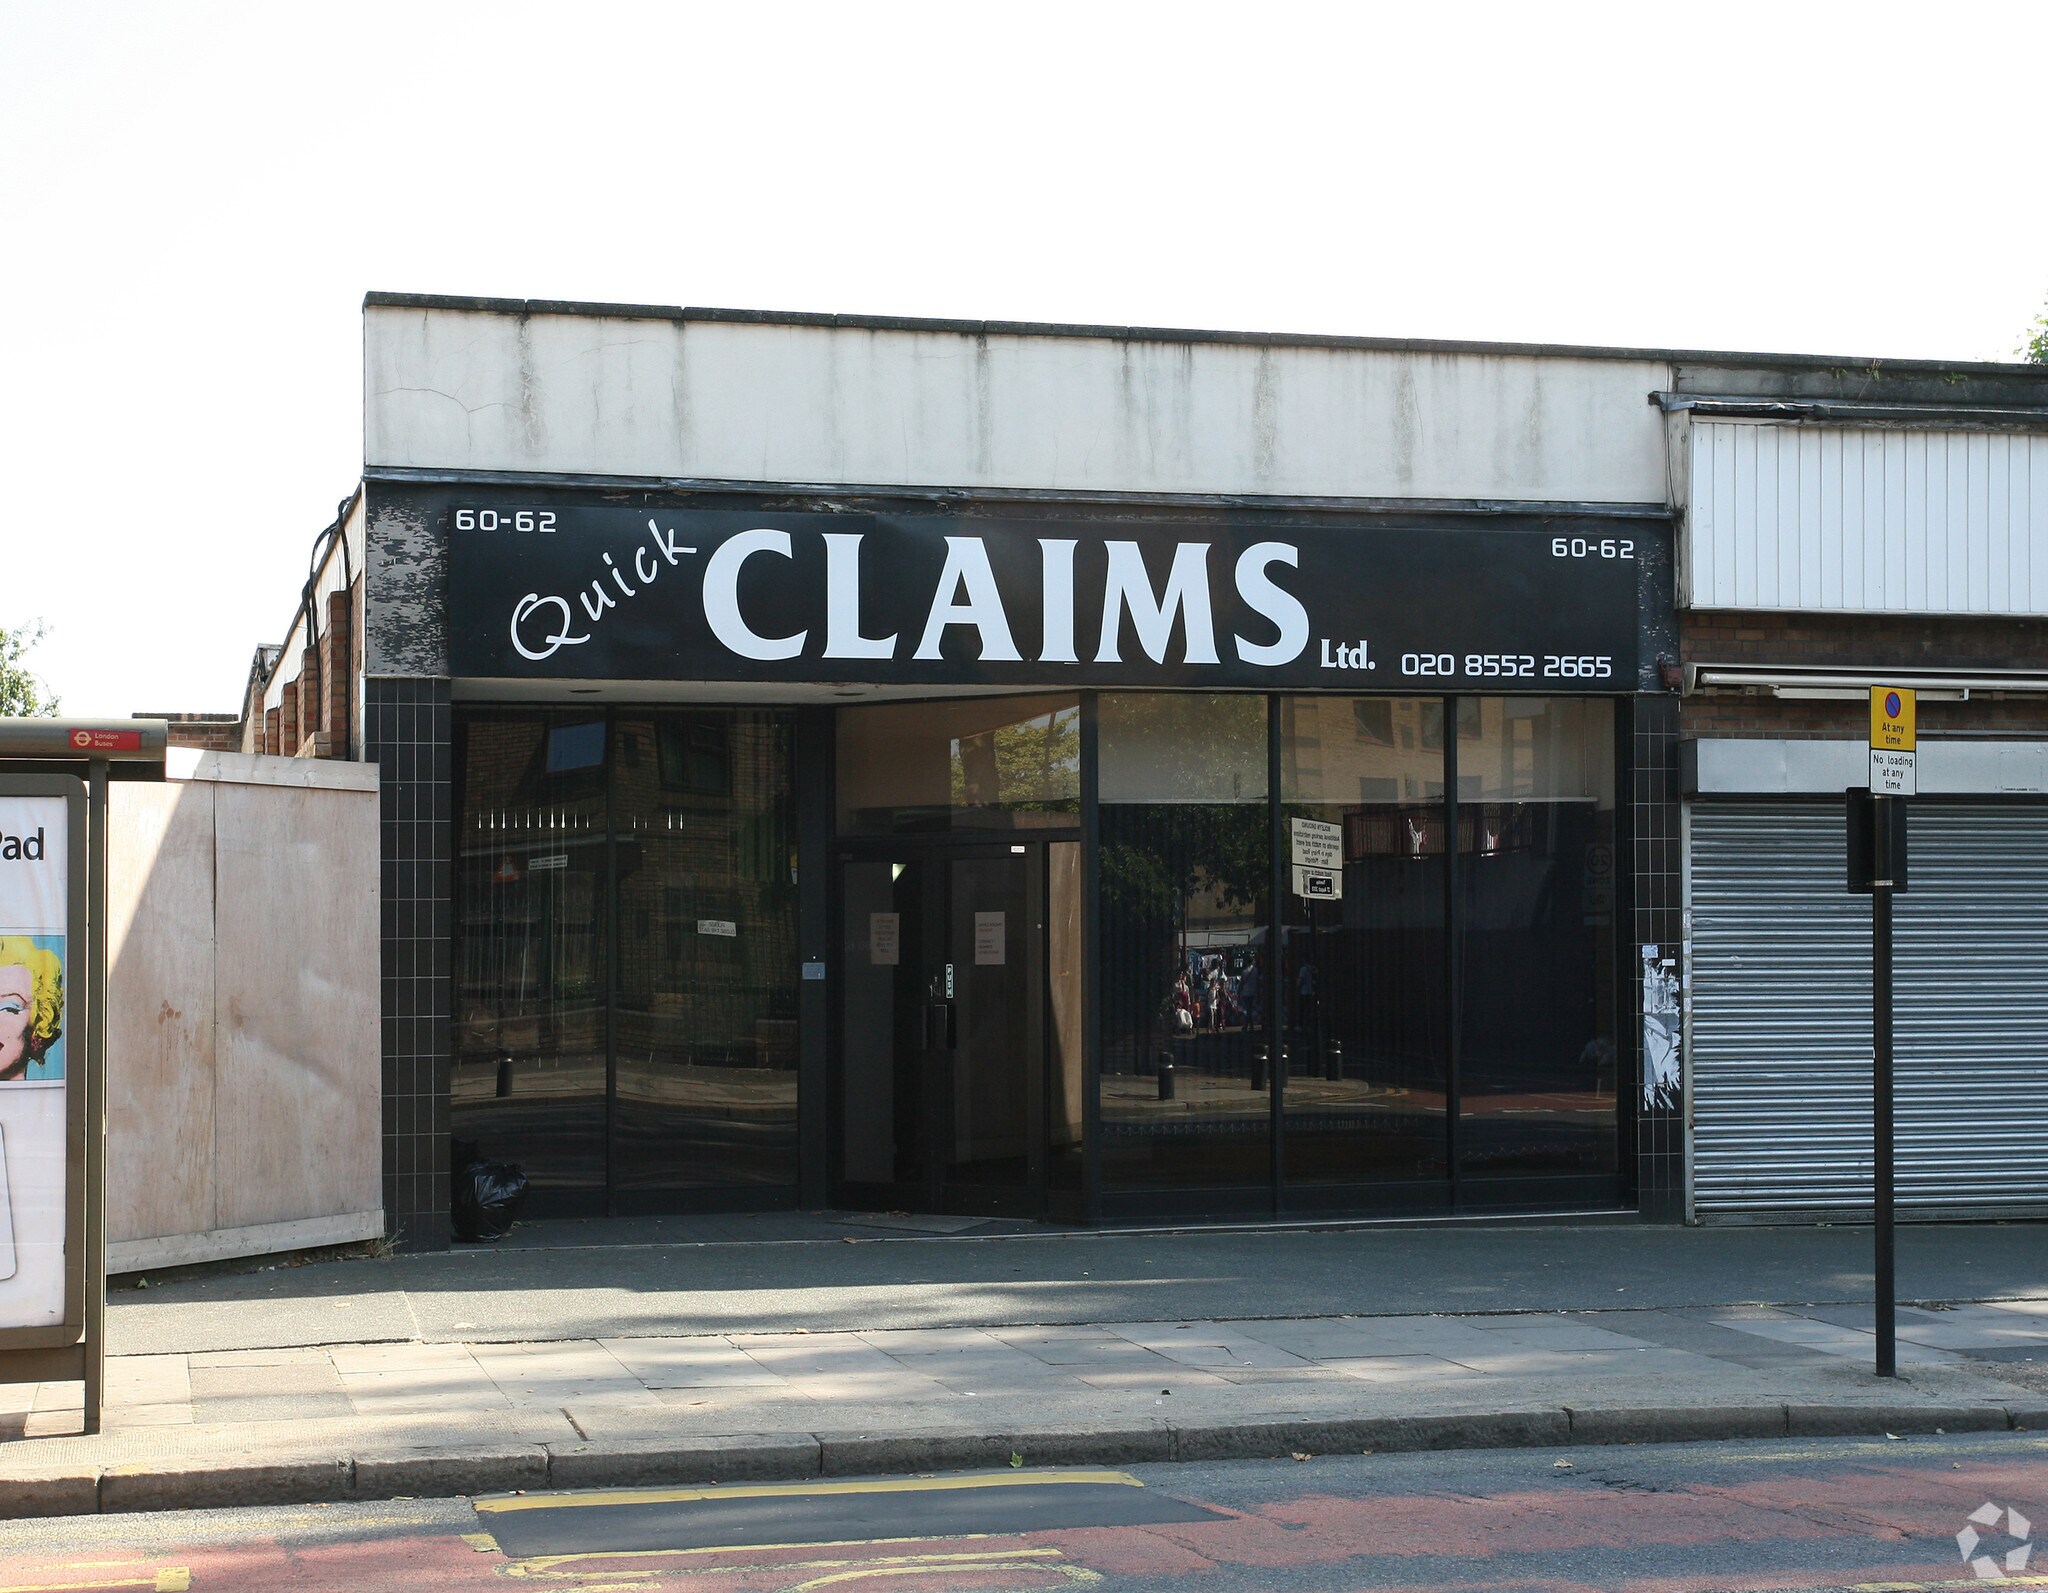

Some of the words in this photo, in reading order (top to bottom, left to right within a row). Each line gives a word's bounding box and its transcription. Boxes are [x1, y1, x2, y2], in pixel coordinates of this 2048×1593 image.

[455, 509, 556, 533] 60-62
[1551, 538, 1635, 560] 60-62
[510, 519, 698, 661] Quick
[702, 528, 1310, 667] CLAIMS
[1320, 638, 1376, 670] Ltd.
[1401, 653, 1455, 676] 020
[1464, 654, 1535, 677] 8552
[1543, 655, 1612, 678] 2665
[1881, 722, 1891, 732] At
[1892, 724, 1905, 735] any
[94, 732, 119, 740] London
[1885, 735, 1901, 745] time
[1873, 754, 1884, 764] No
[1887, 755, 1913, 768] loading
[1882, 767, 1891, 777] at
[1892, 769, 1904, 780] any
[1885, 779, 1901, 790] time
